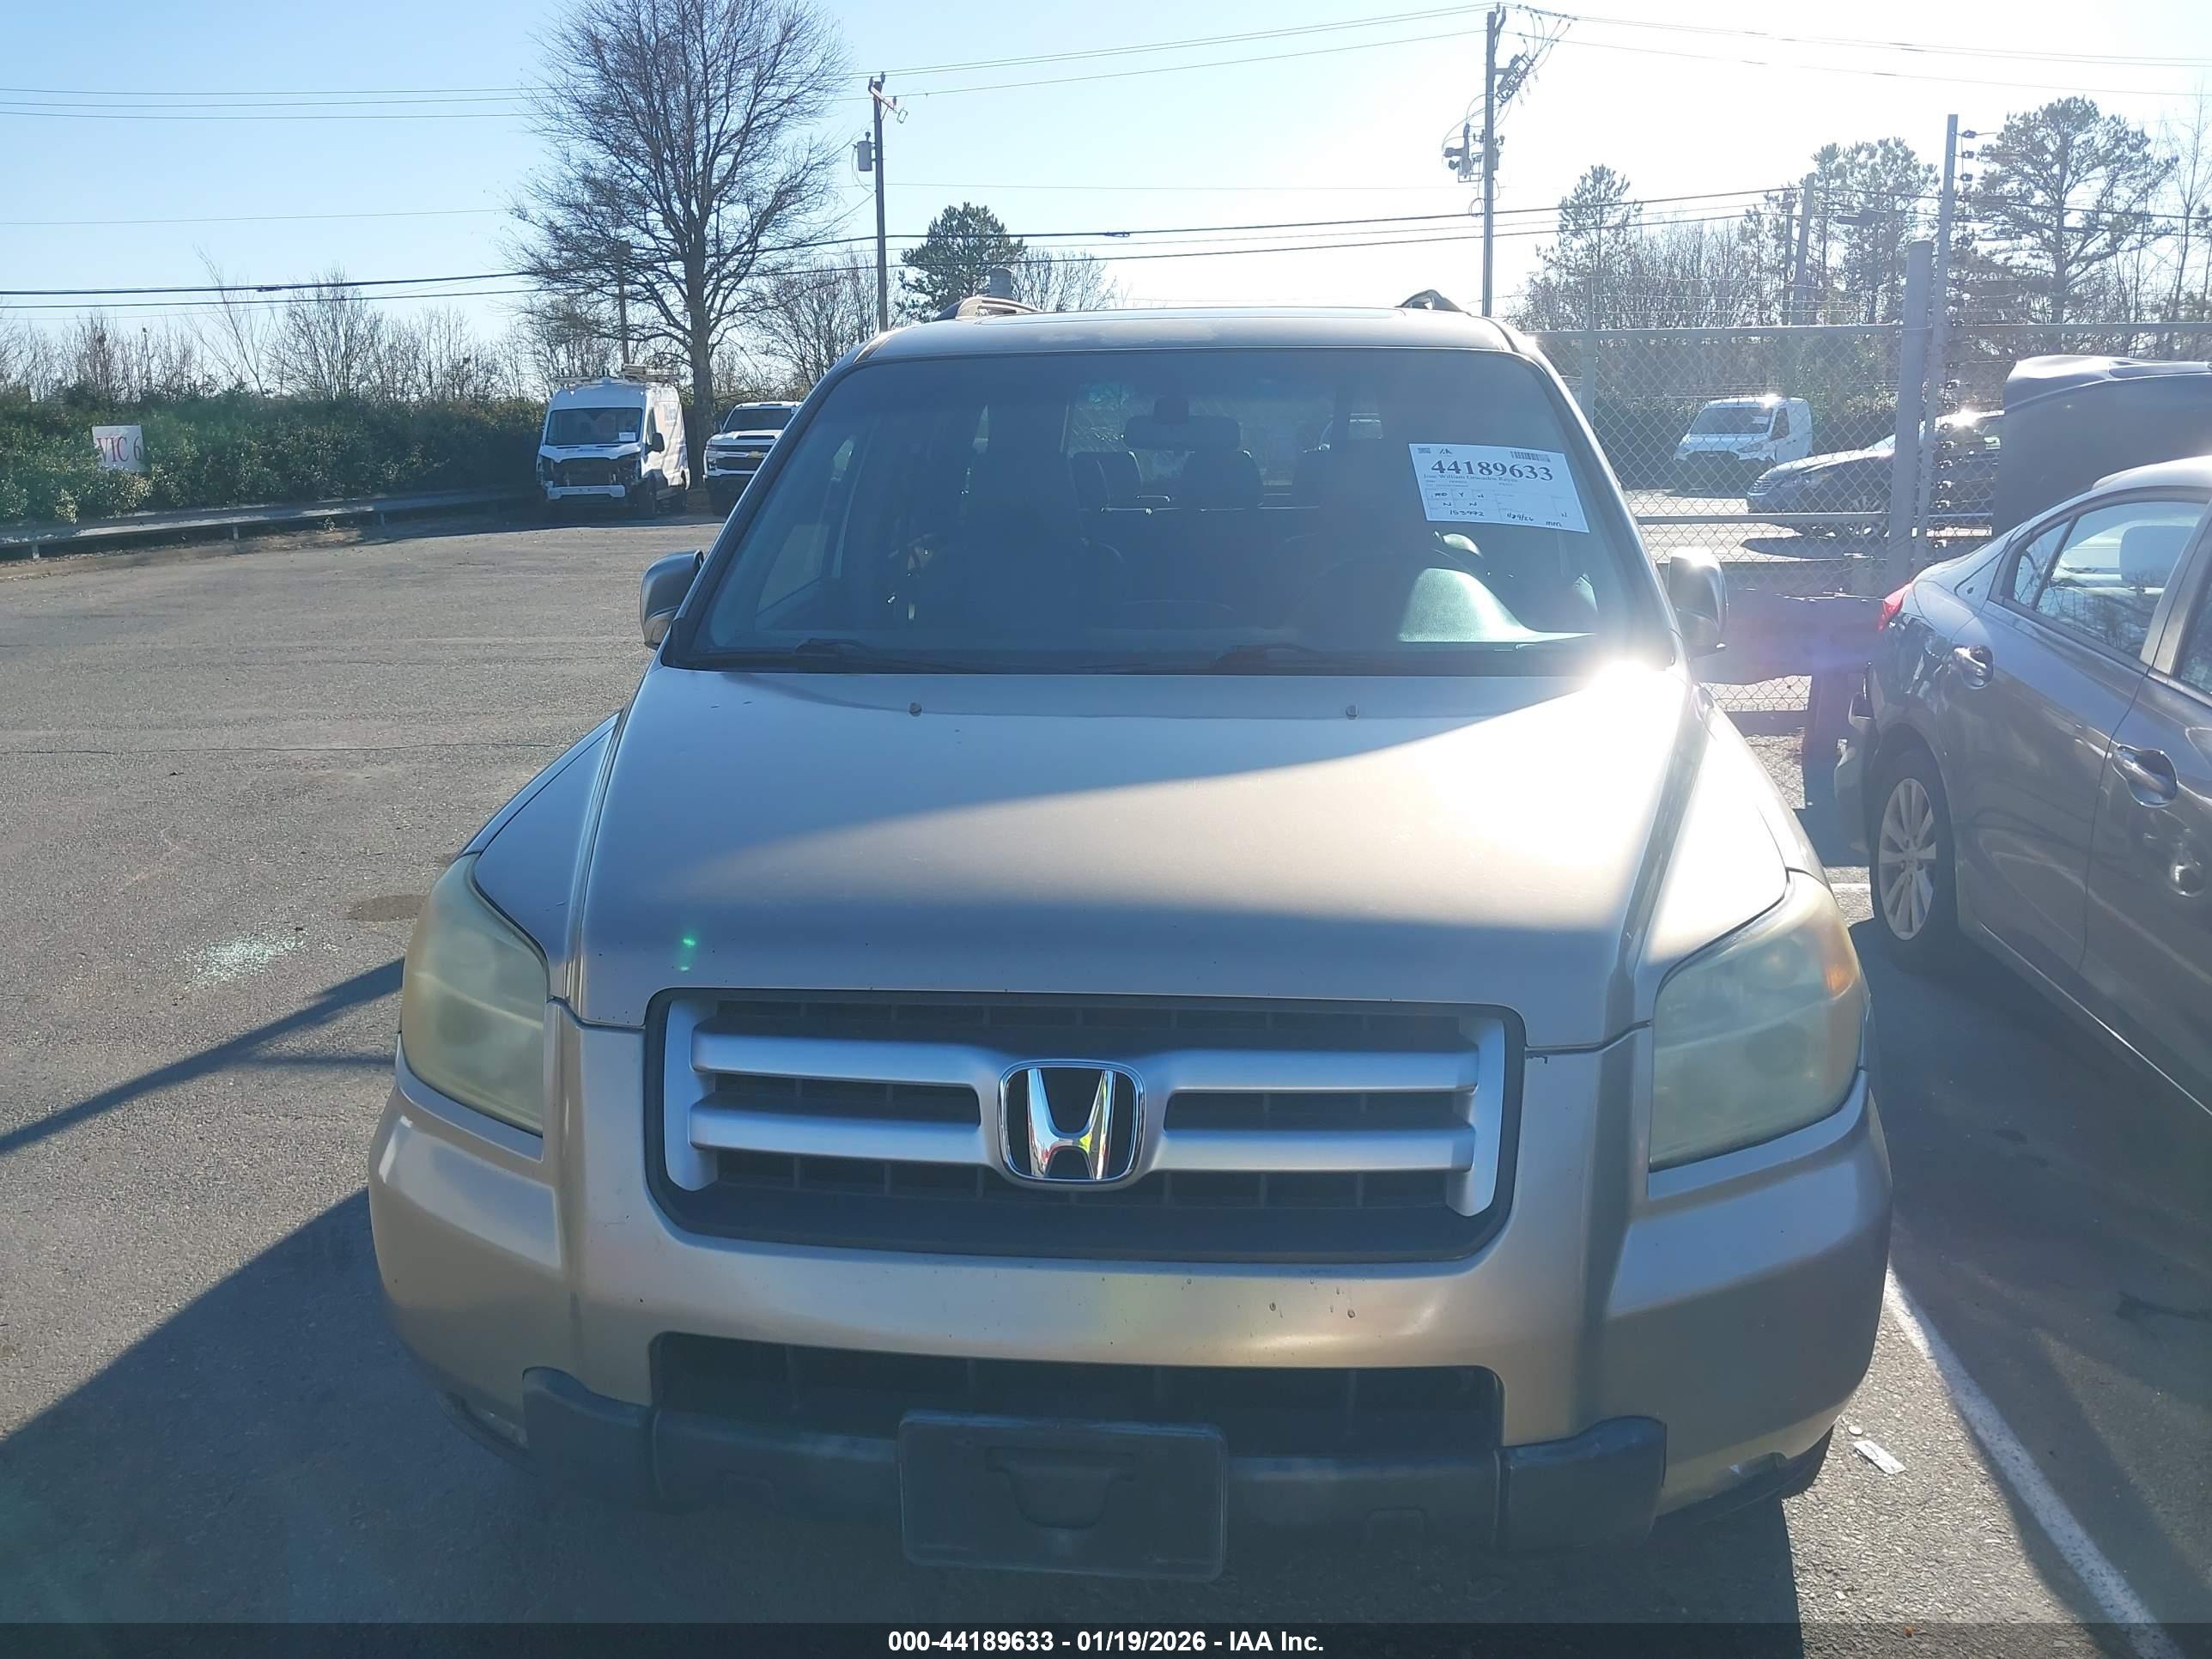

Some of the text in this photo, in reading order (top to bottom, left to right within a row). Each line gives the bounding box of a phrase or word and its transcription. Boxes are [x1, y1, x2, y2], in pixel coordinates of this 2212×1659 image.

[96, 435, 142, 463] VIC 6
[1431, 459, 1553, 482] 44189633
